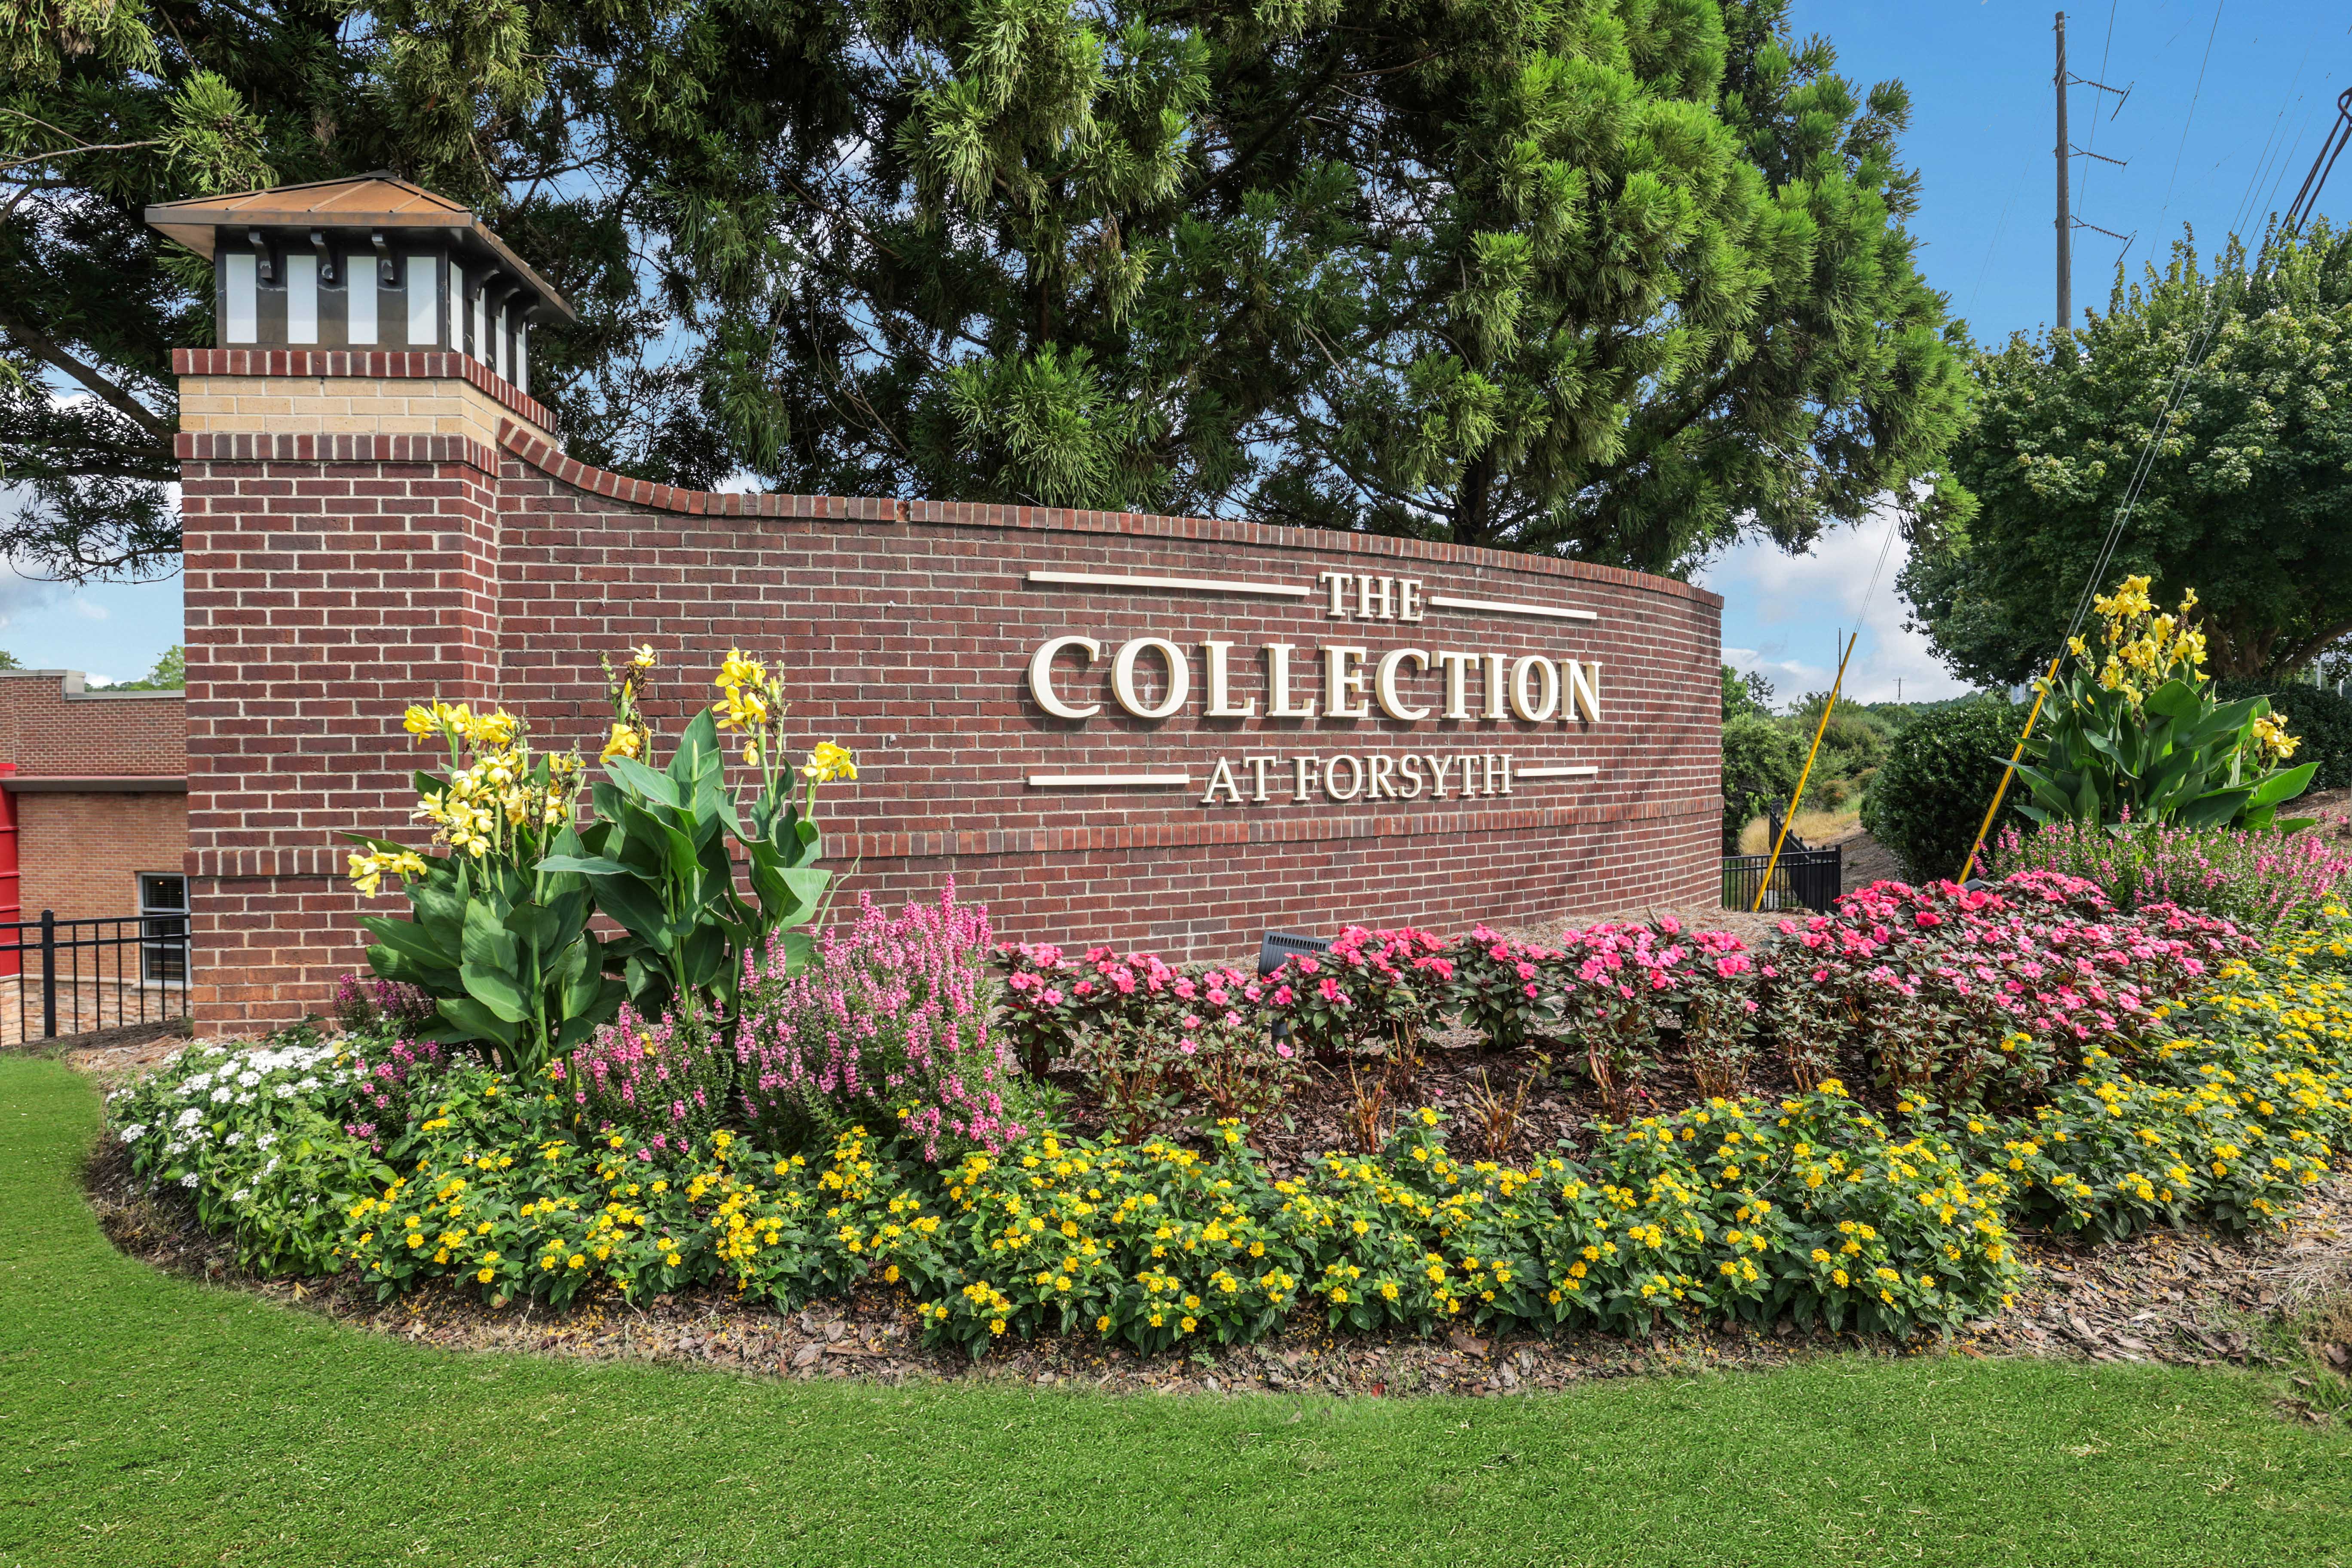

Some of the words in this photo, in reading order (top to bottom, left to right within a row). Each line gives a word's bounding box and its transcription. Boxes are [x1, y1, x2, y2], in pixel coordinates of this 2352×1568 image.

[1319, 571, 1424, 622] THE
[1029, 635, 1603, 722] COLLECTION
[1200, 755, 1277, 802] AT
[1292, 753, 1513, 801] FORSYTH
